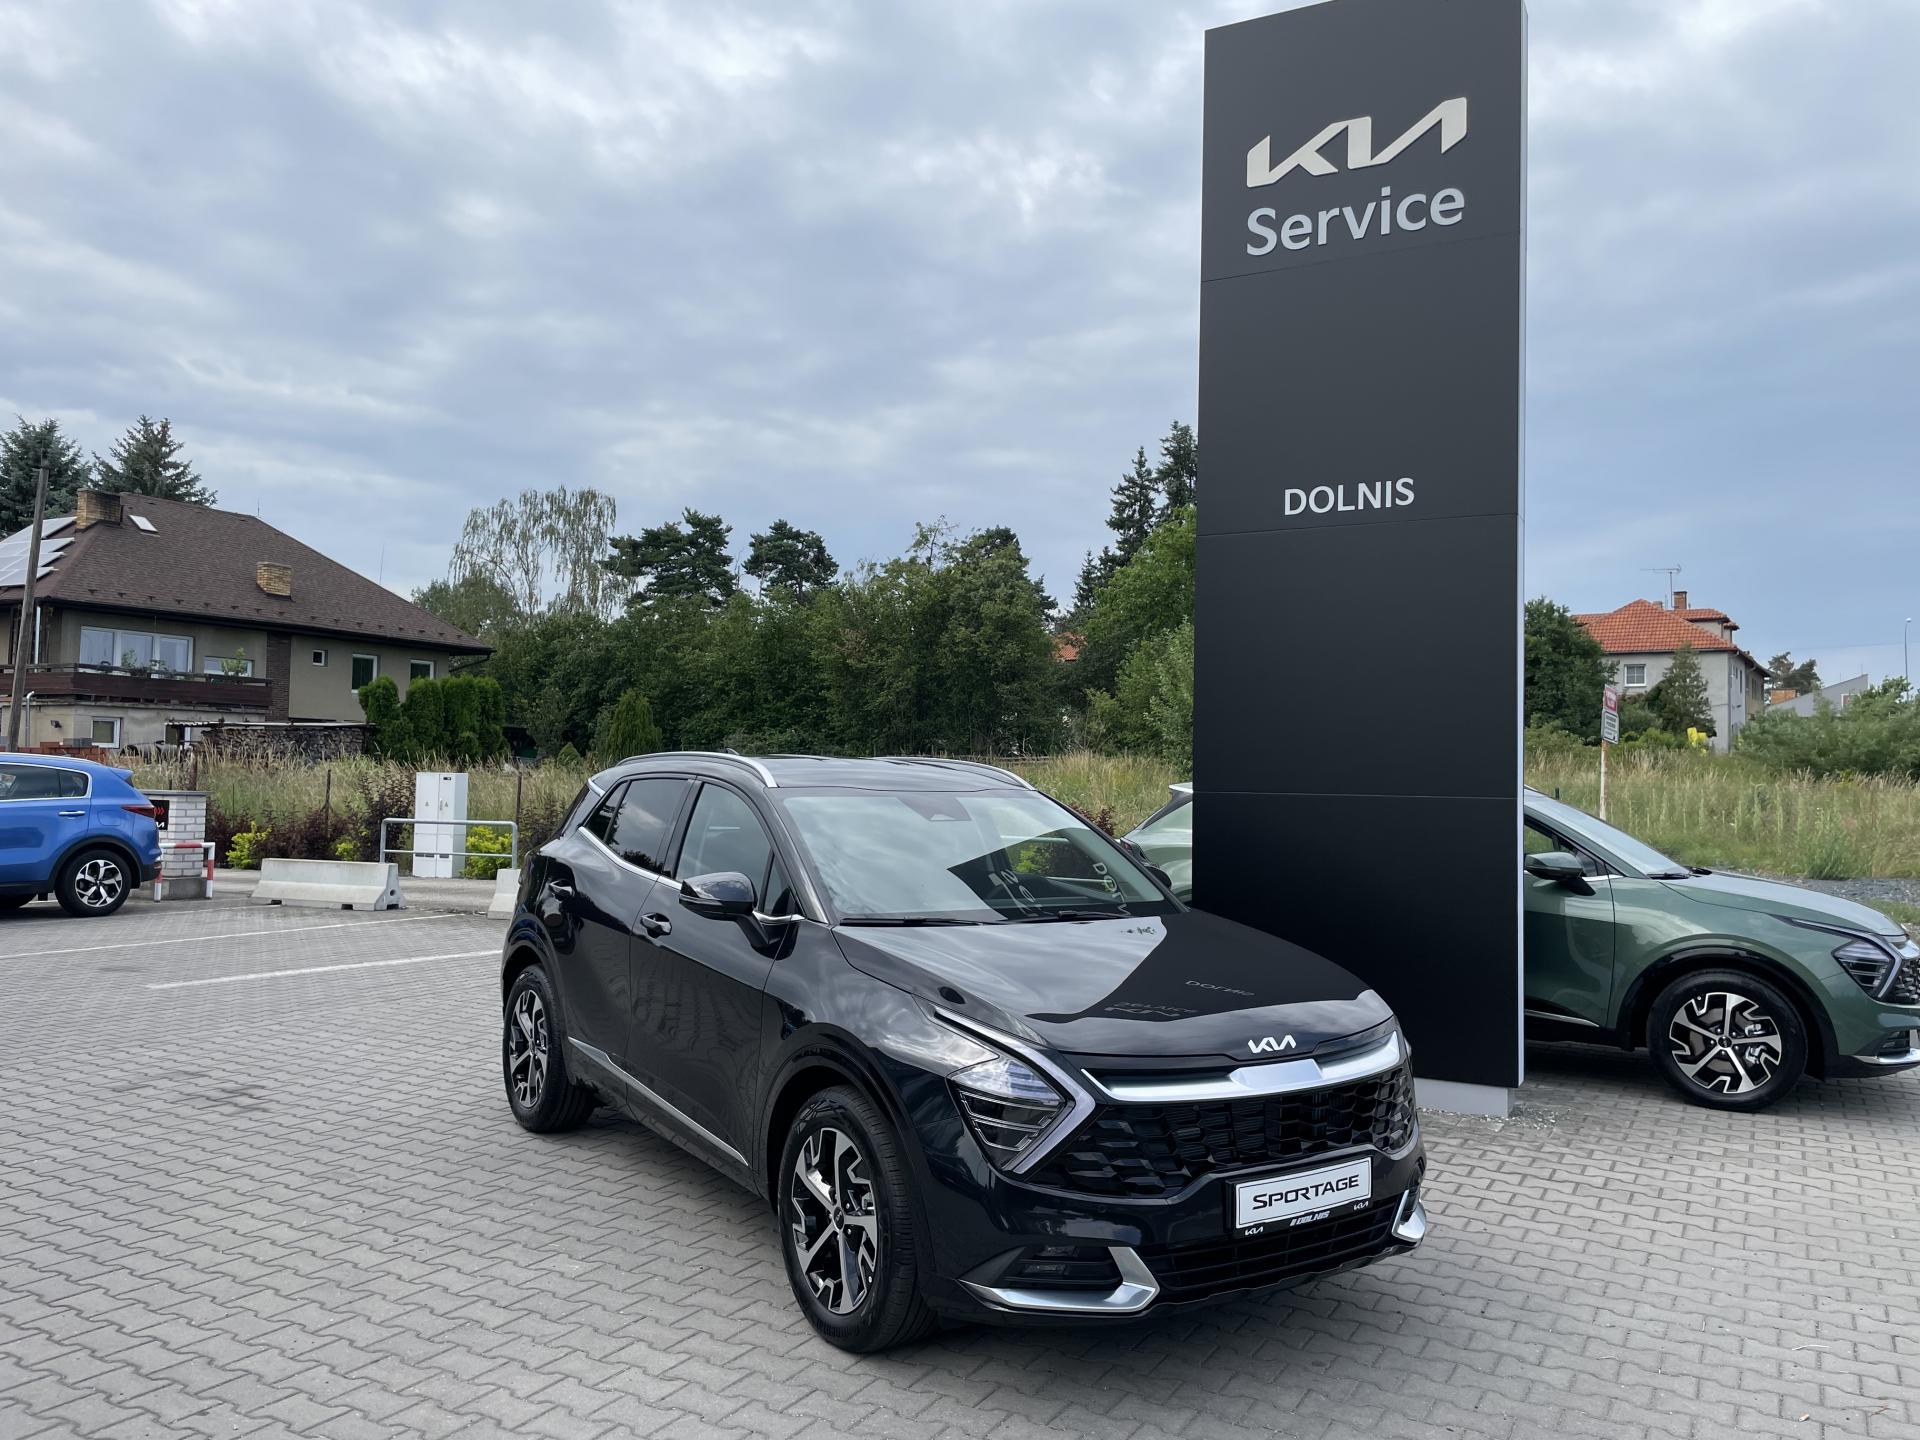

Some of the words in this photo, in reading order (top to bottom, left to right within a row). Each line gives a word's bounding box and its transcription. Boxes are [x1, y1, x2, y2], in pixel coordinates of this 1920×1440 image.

[1246, 97, 1468, 188] KIA
[1246, 186, 1465, 256] Service
[1284, 477, 1415, 516] DOLNIS
[1247, 1034, 1297, 1054] KIA
[1252, 1175, 1360, 1210] SPORTAGE
[1354, 1201, 1369, 1211] KIA
[1244, 1226, 1264, 1236] KIA
